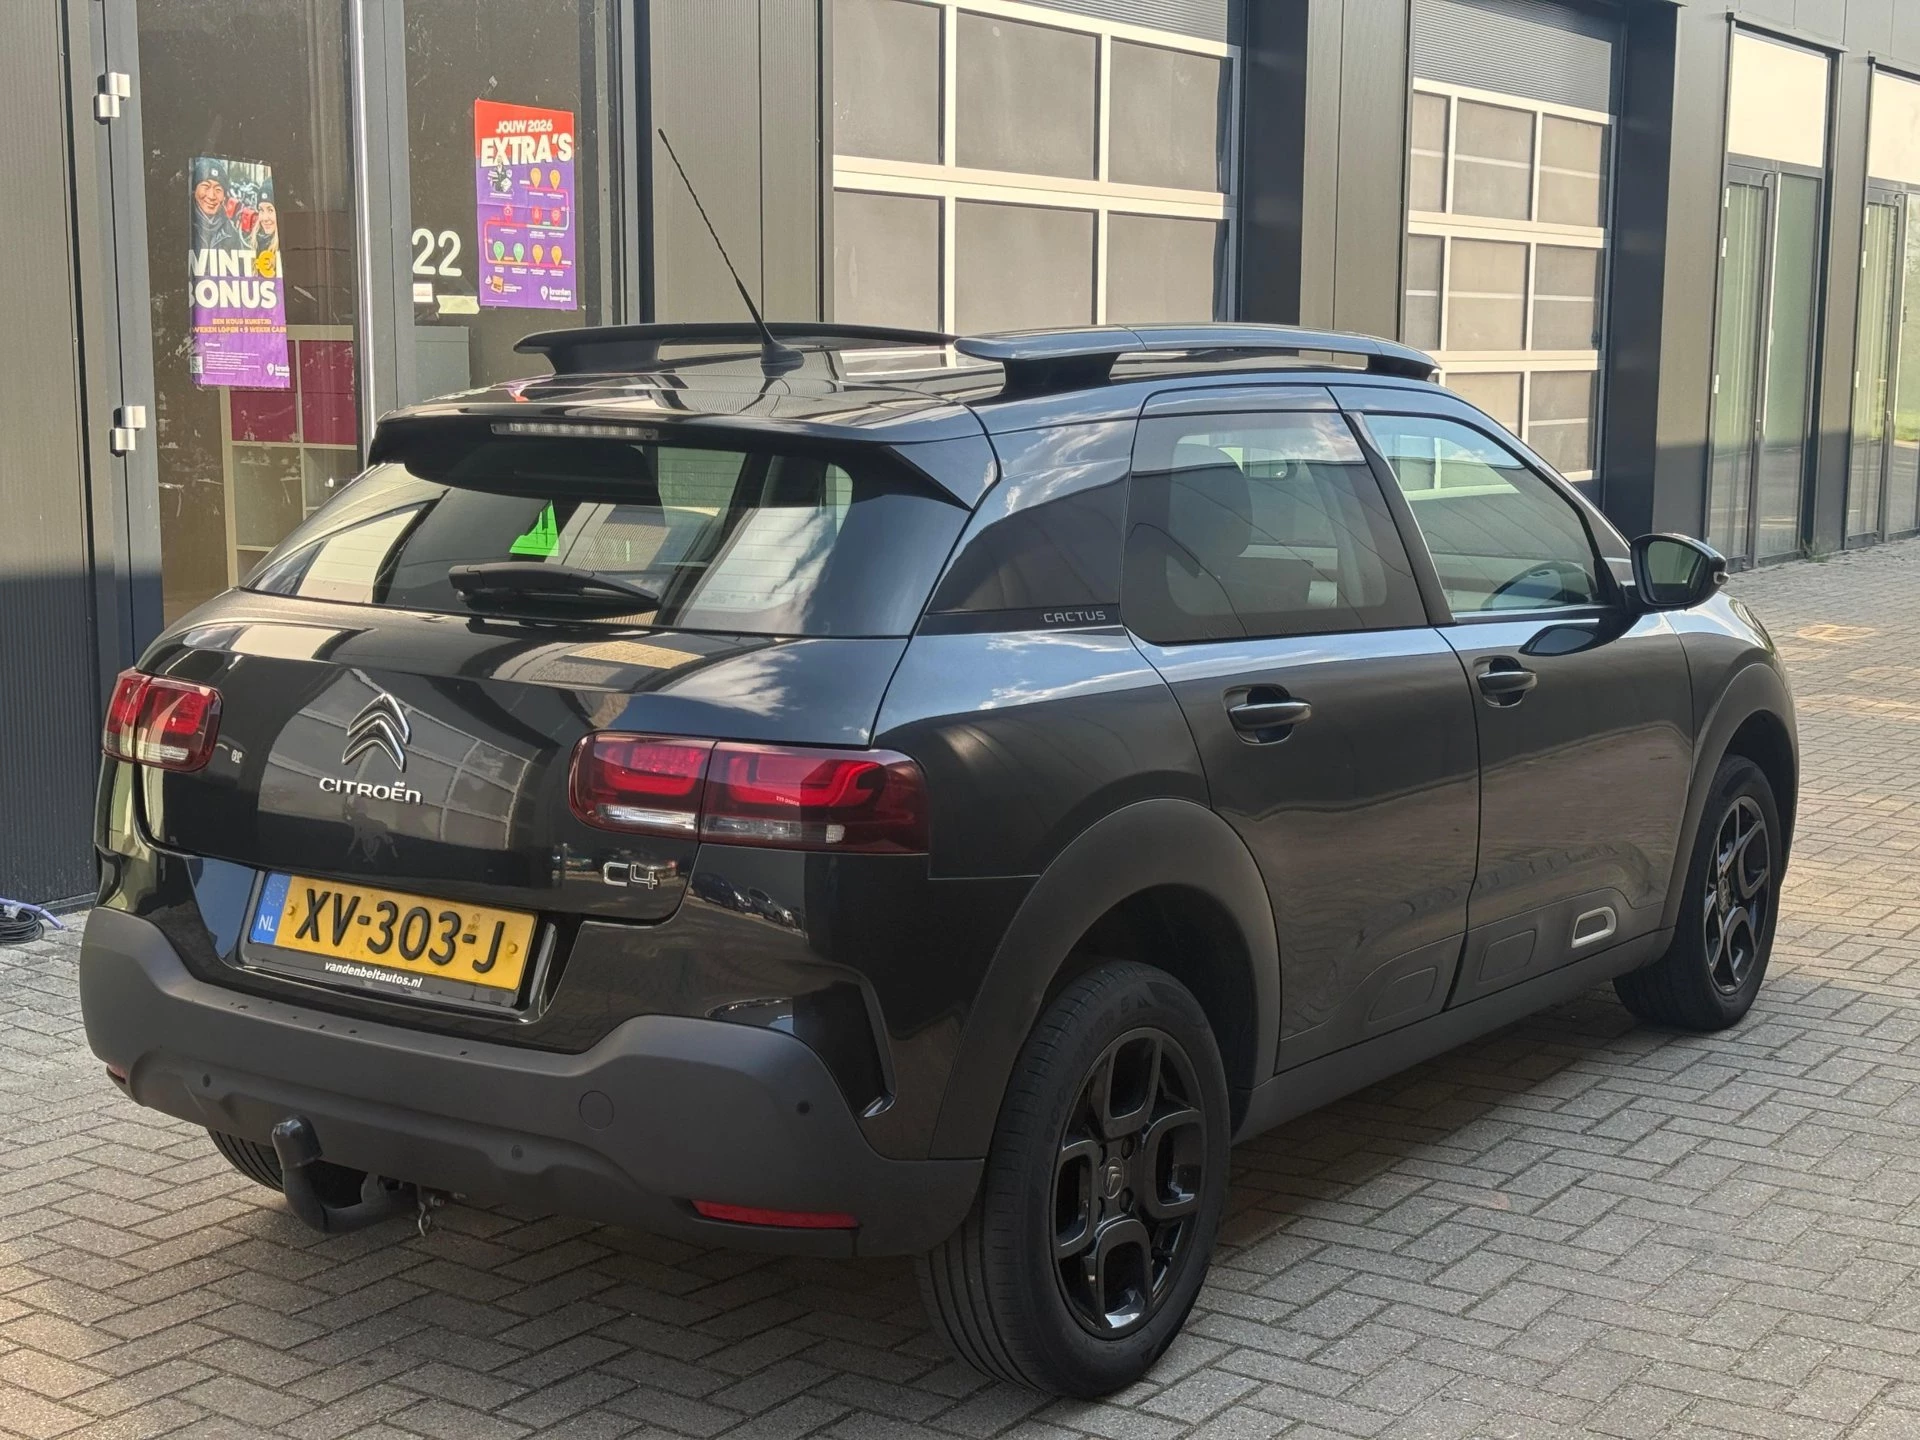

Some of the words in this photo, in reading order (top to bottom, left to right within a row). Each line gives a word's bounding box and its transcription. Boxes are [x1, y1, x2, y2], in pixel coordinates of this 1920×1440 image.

[495, 120, 527, 134] JOUW
[527, 118, 553, 133] 2026
[480, 132, 573, 167] EXTRA'S
[411, 228, 462, 277] 22
[1043, 610, 1106, 623] CACTUS
[602, 861, 658, 890] C4
[257, 917, 275, 932] NL
[295, 888, 505, 974] XV-303-J
[324, 960, 423, 989] vandenbeltautos.nl
